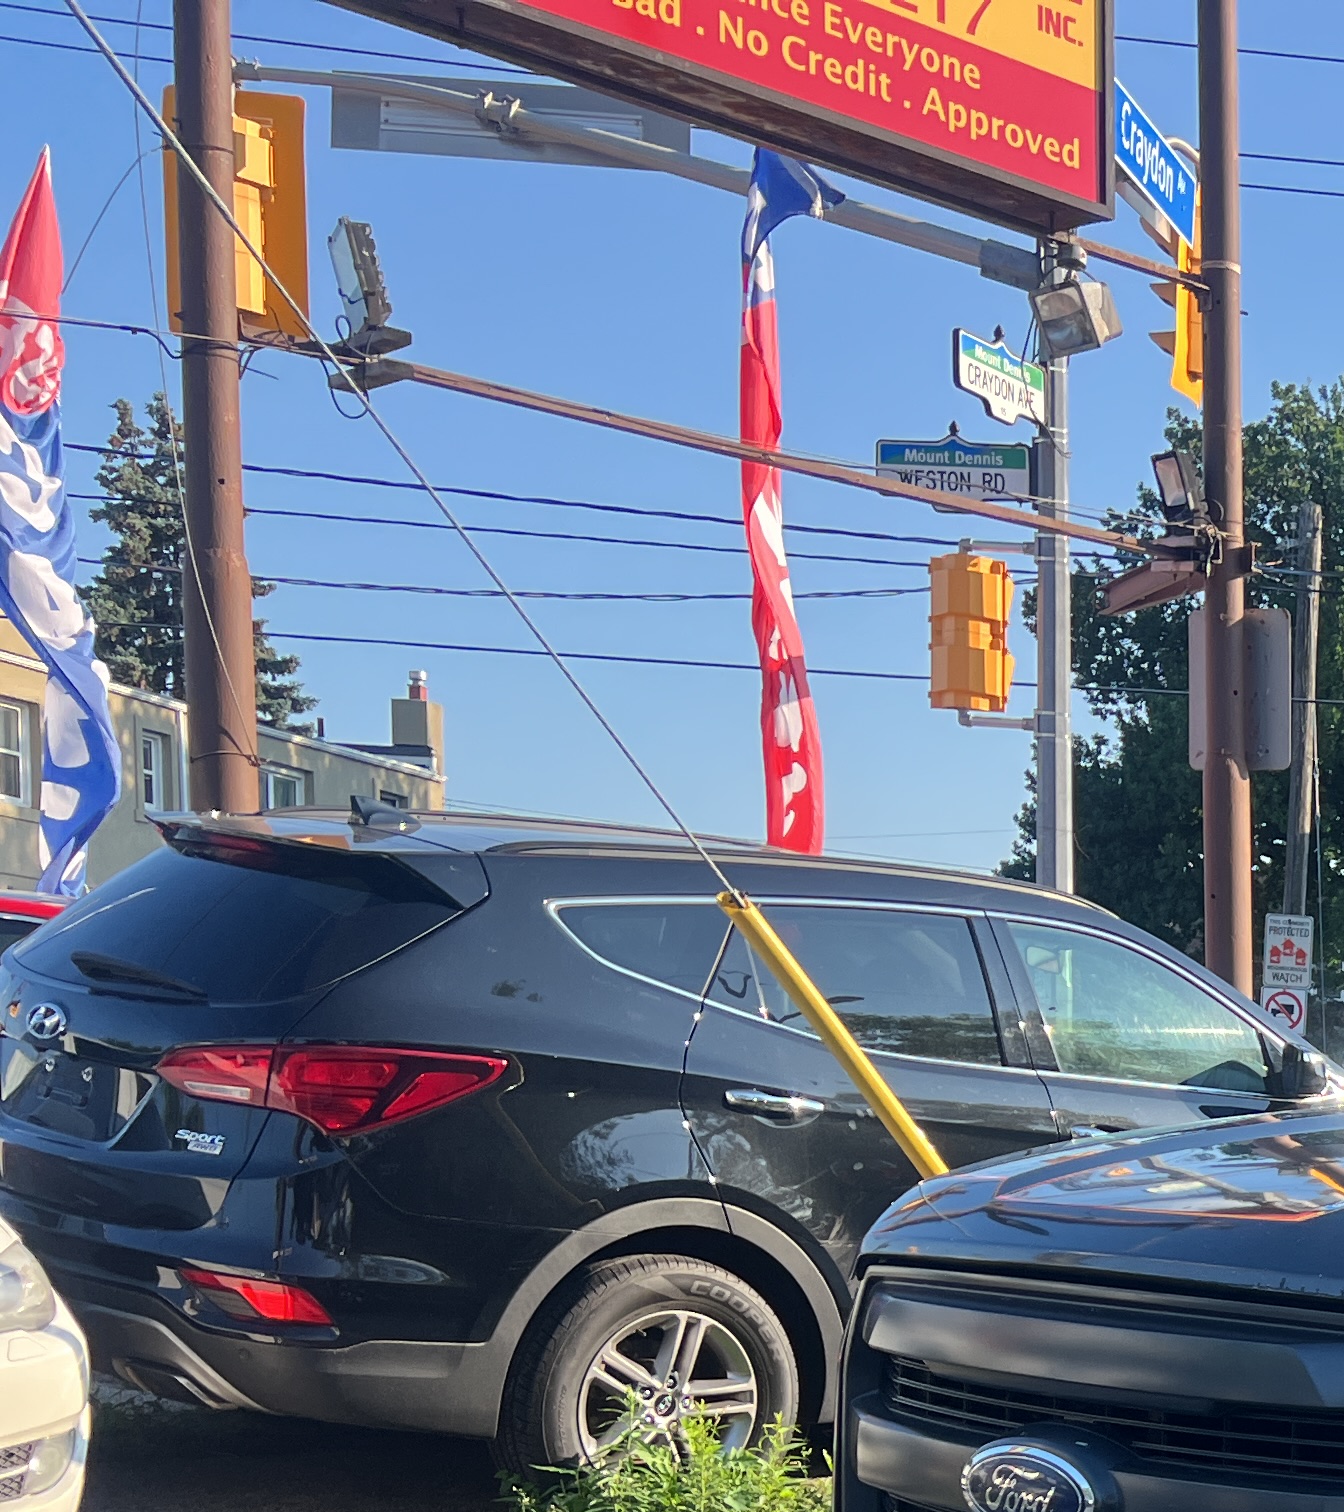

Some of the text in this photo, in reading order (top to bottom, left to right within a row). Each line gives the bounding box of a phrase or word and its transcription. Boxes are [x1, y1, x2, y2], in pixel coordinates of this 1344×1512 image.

[1037, 4, 1084, 48] INC.
[824, 2, 982, 90] Everyone
[719, 9, 769, 57] No
[781, 35, 893, 103] Credit
[921, 86, 1081, 170] Approved
[1121, 101, 1174, 204] Craydon
[974, 343, 1002, 370] Mount
[967, 362, 1016, 404] CRAYDON
[904, 447, 1004, 466] Mount Dennis
[900, 469, 1006, 494] WESTON RD
[1268, 925, 1310, 938] PROTECTED
[1271, 972, 1303, 984] WATCH
[174, 1129, 226, 1146] Sport
[690, 1279, 784, 1361] COOPER
